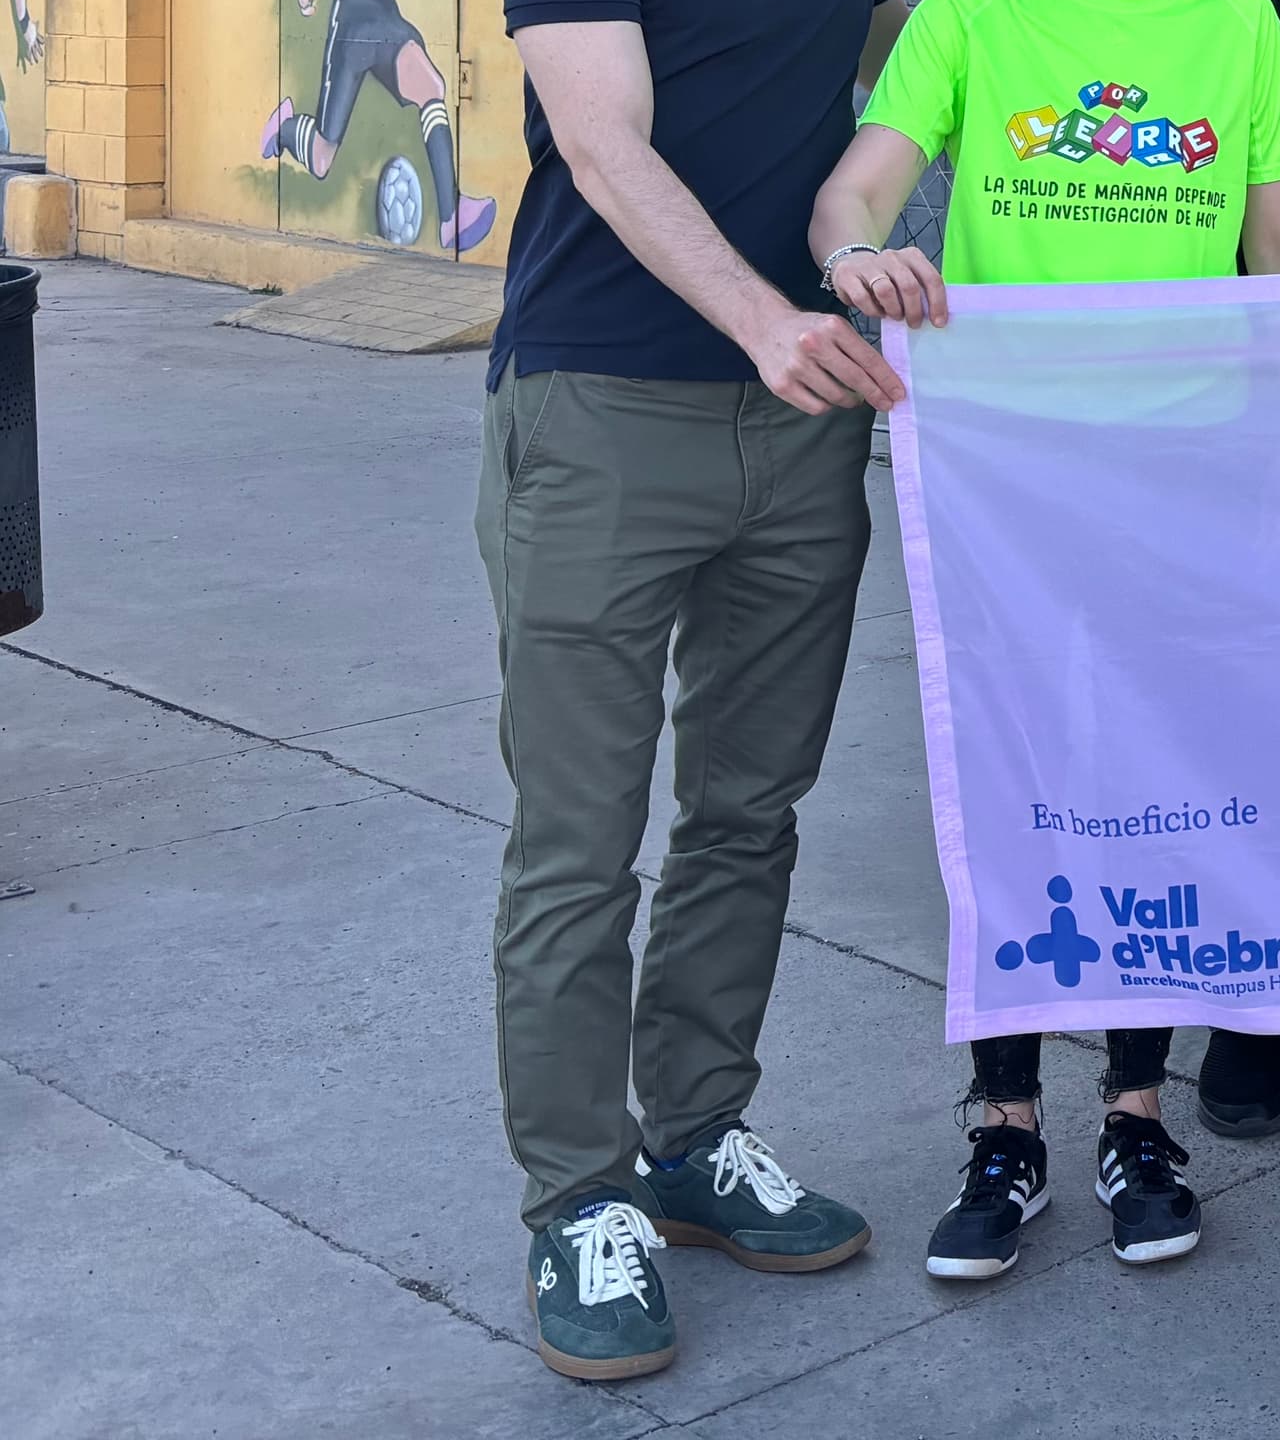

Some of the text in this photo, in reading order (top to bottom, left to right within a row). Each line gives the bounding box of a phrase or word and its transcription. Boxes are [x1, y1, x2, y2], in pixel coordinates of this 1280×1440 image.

[1085, 83, 1144, 105] POR
[984, 175, 1227, 210] LA SALUD DE MAÑANA DEPENDE
[991, 199, 1218, 230] DE LA INVESTIGACIÓN DE HOY
[1031, 797, 1259, 839] En beneficio de
[1099, 883, 1200, 930] Vall
[1120, 972, 1200, 992] Barcelona
[1201, 978, 1266, 998] Campus
